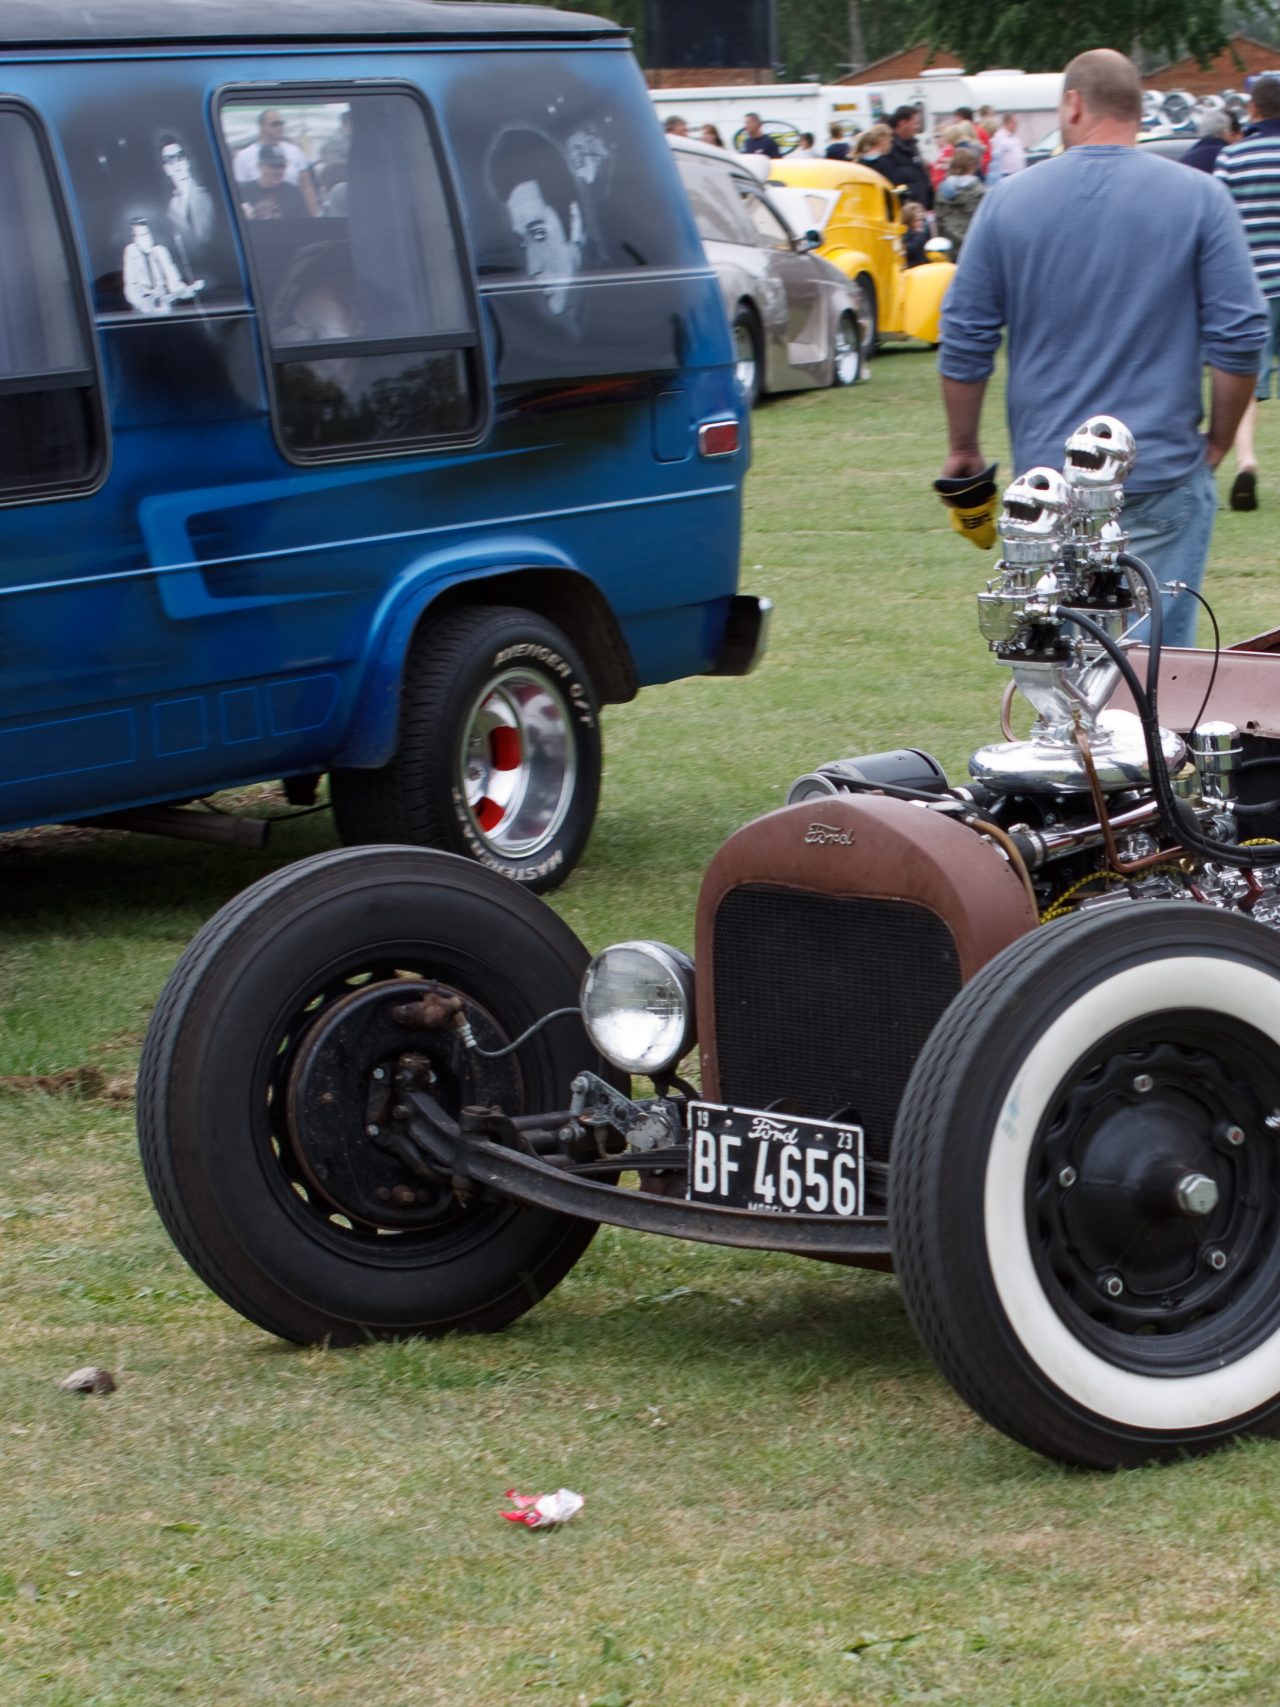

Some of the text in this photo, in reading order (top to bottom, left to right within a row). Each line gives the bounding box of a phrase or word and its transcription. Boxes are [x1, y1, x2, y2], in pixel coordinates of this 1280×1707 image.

[804, 822, 856, 845] Ford
[697, 1111, 853, 1149] 19 Ford 23
[694, 1130, 856, 1216] BF 4656
